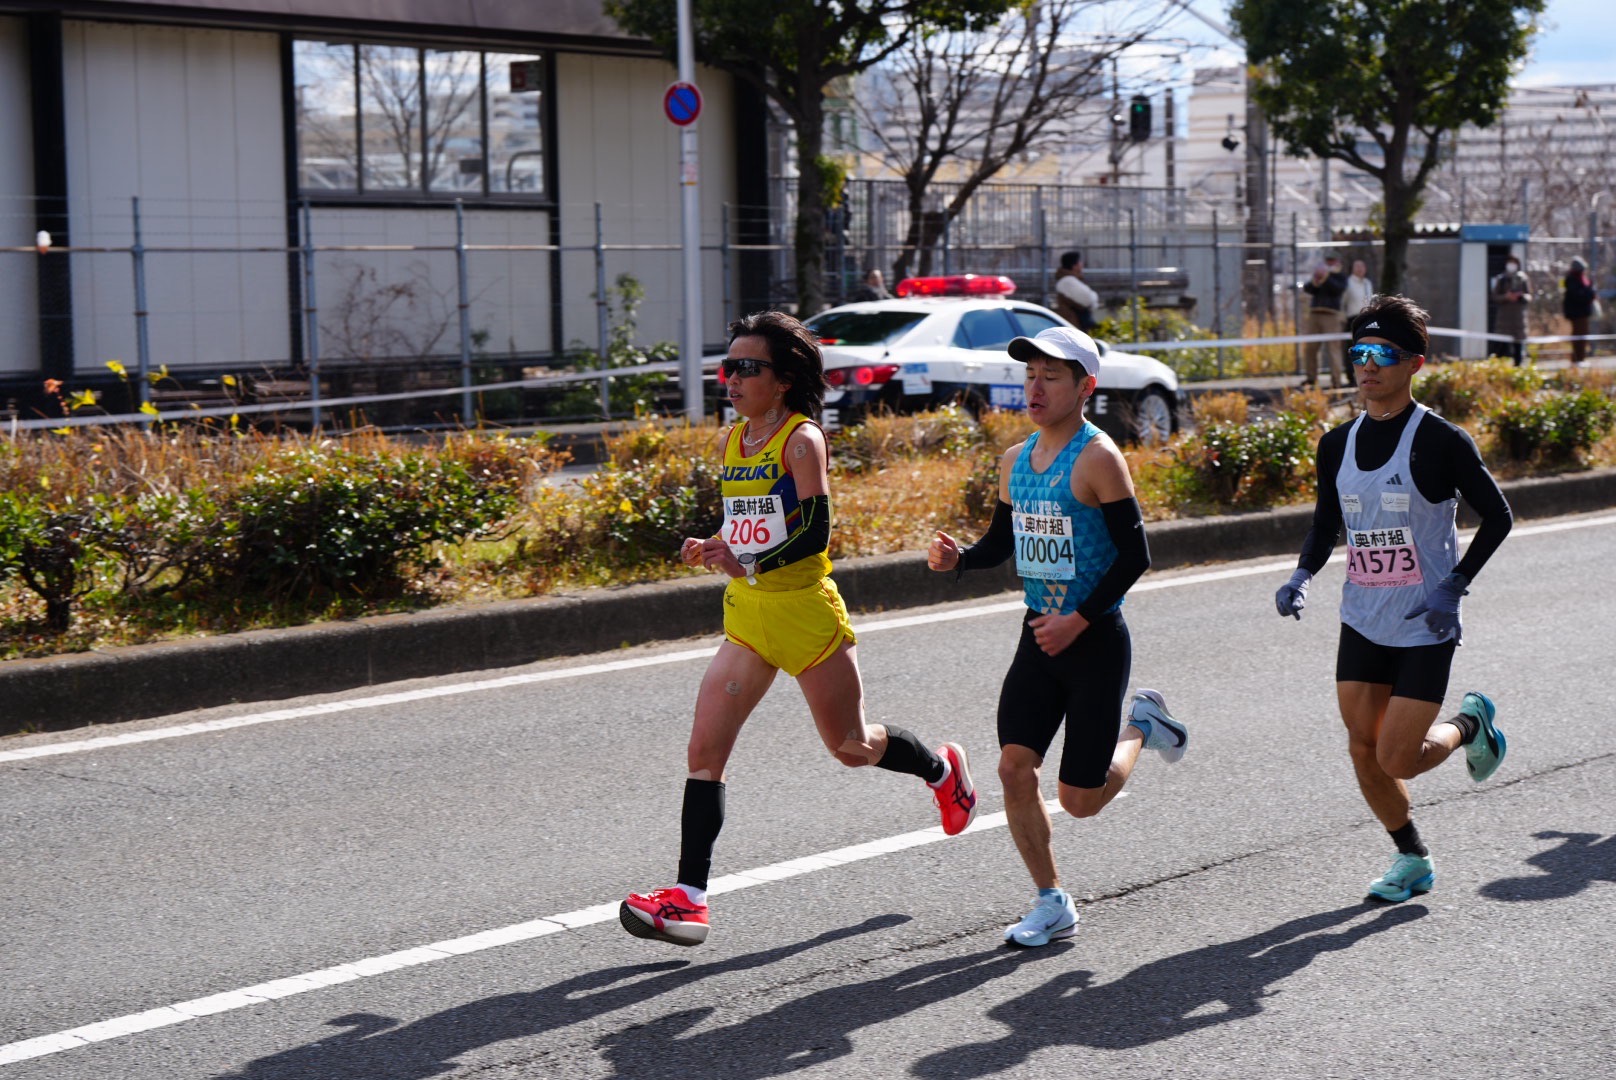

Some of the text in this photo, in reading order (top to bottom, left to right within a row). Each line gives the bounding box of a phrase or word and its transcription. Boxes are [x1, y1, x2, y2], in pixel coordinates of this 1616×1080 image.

[733, 498, 776, 516] 奥村組
[730, 518, 770, 545] 206
[1025, 516, 1065, 536] 奥村組
[1020, 536, 1073, 564] 10004
[1354, 530, 1406, 548] 奥村組
[1348, 548, 1416, 574] A1573
